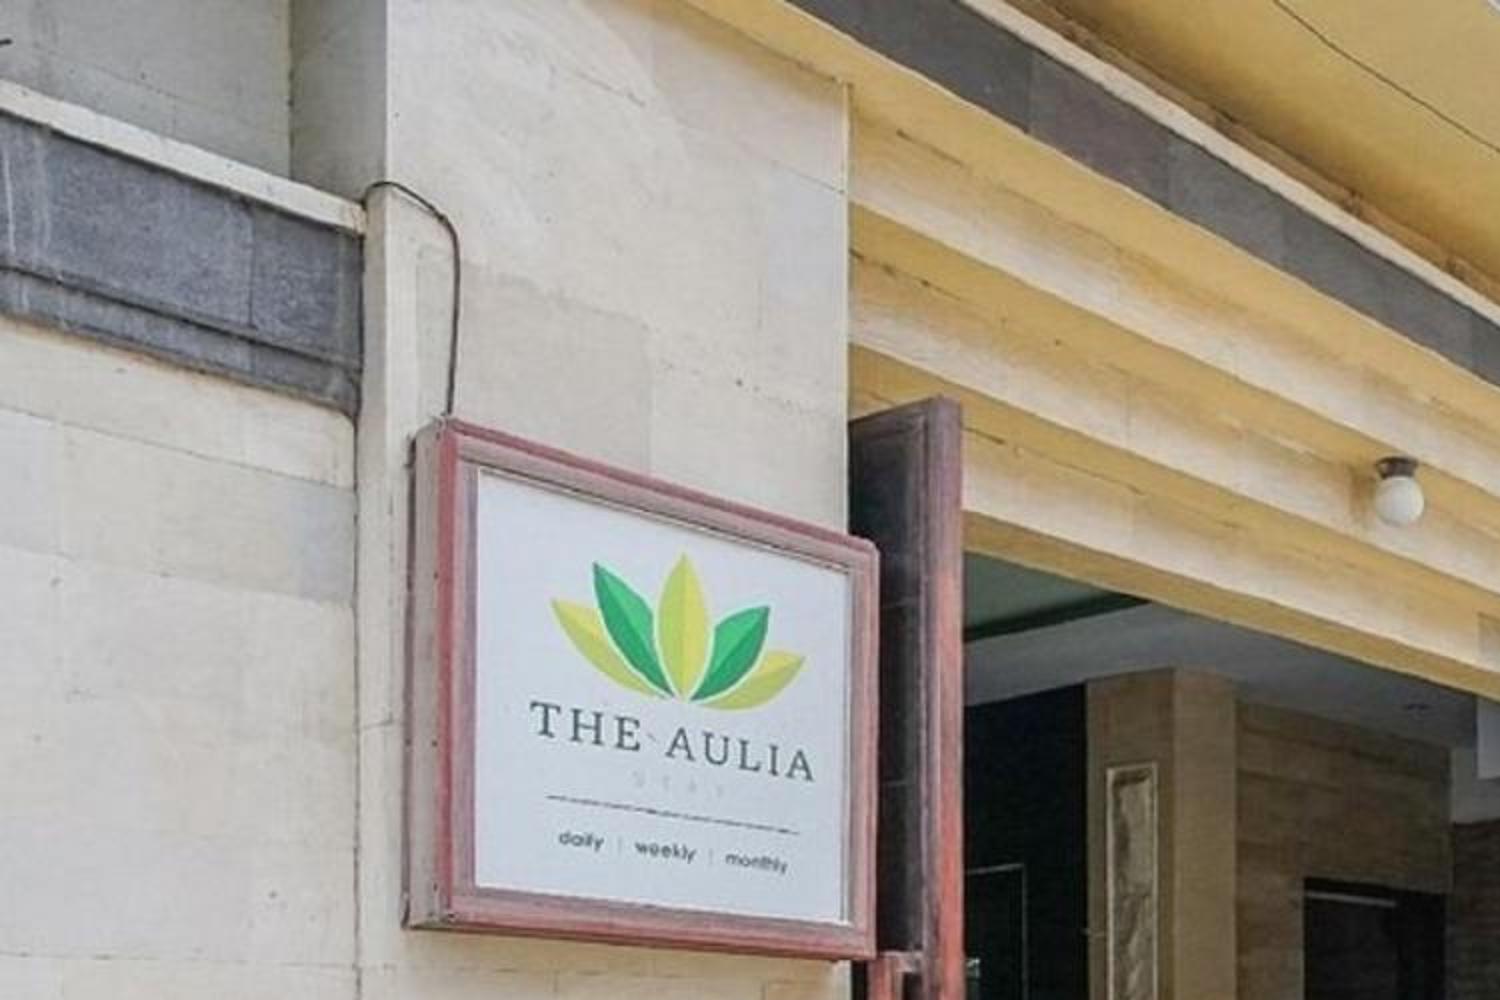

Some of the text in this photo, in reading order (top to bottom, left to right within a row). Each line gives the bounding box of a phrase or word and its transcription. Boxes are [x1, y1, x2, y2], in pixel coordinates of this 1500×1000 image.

[530, 701, 815, 782] THE AULIA
[558, 830, 789, 875] daily weekly monthly
